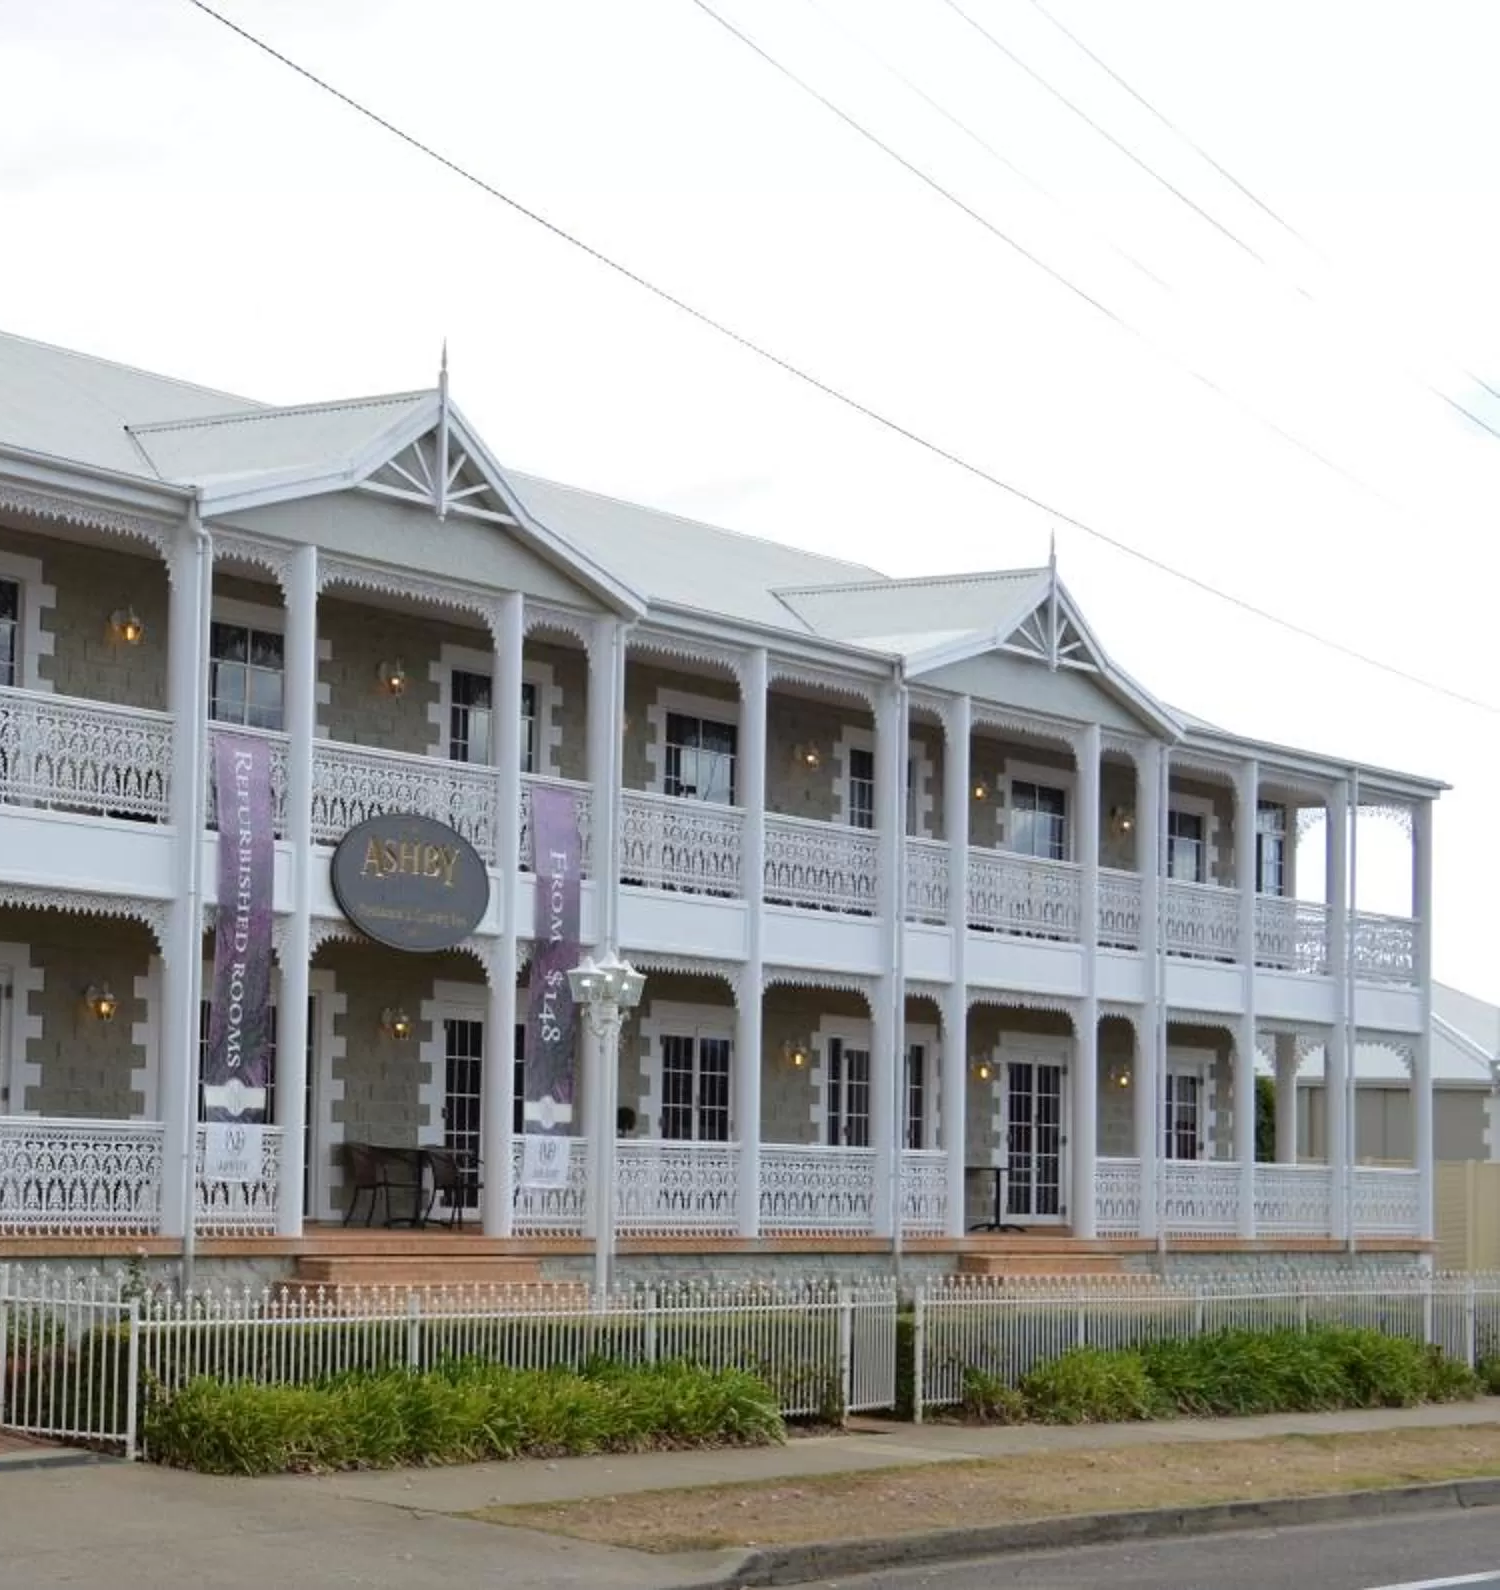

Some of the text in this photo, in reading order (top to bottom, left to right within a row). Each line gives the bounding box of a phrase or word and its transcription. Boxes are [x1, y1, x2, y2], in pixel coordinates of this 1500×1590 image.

[226, 750, 254, 1068] REFURBISHED ROOMS
[359, 836, 461, 887] ASHBY
[538, 849, 567, 1043] FROM $148
